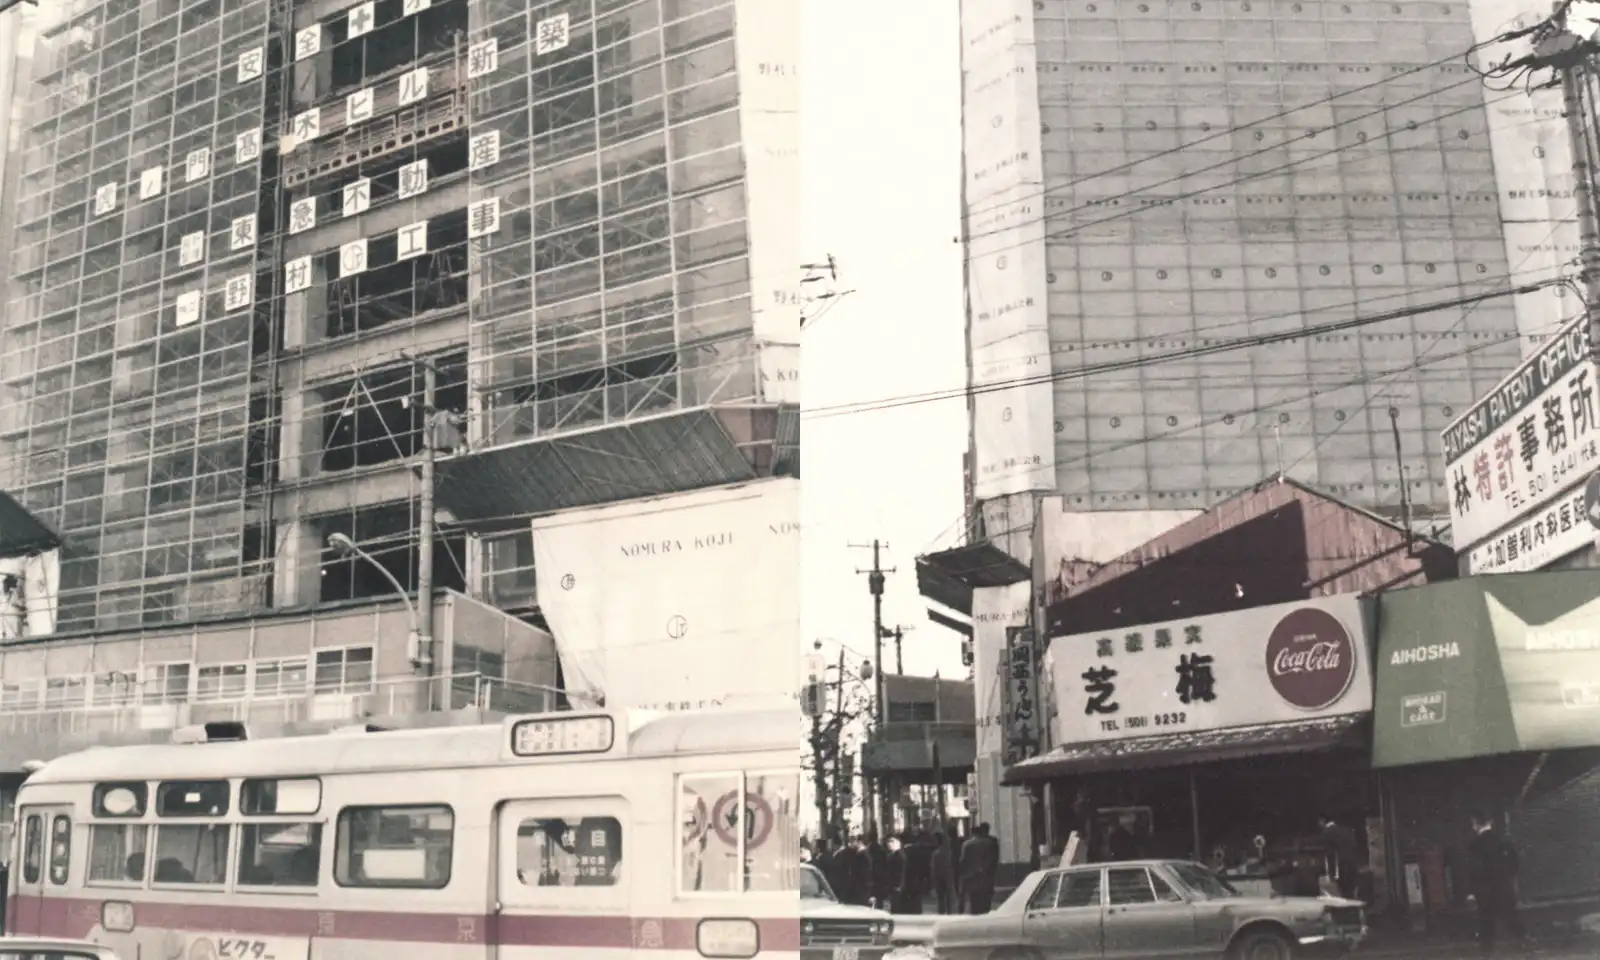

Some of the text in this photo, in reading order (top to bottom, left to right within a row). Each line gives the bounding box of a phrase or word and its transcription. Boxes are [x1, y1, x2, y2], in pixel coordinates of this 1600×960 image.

[1490, 369, 1537, 424] PATENT
[1539, 321, 1590, 385] OFFICE
[620, 531, 734, 558] NOMURA KOJI
[1390, 641, 1461, 666] AIHOSHA
[1100, 719, 1119, 732] TEL
[1154, 711, 1187, 726] 9232
